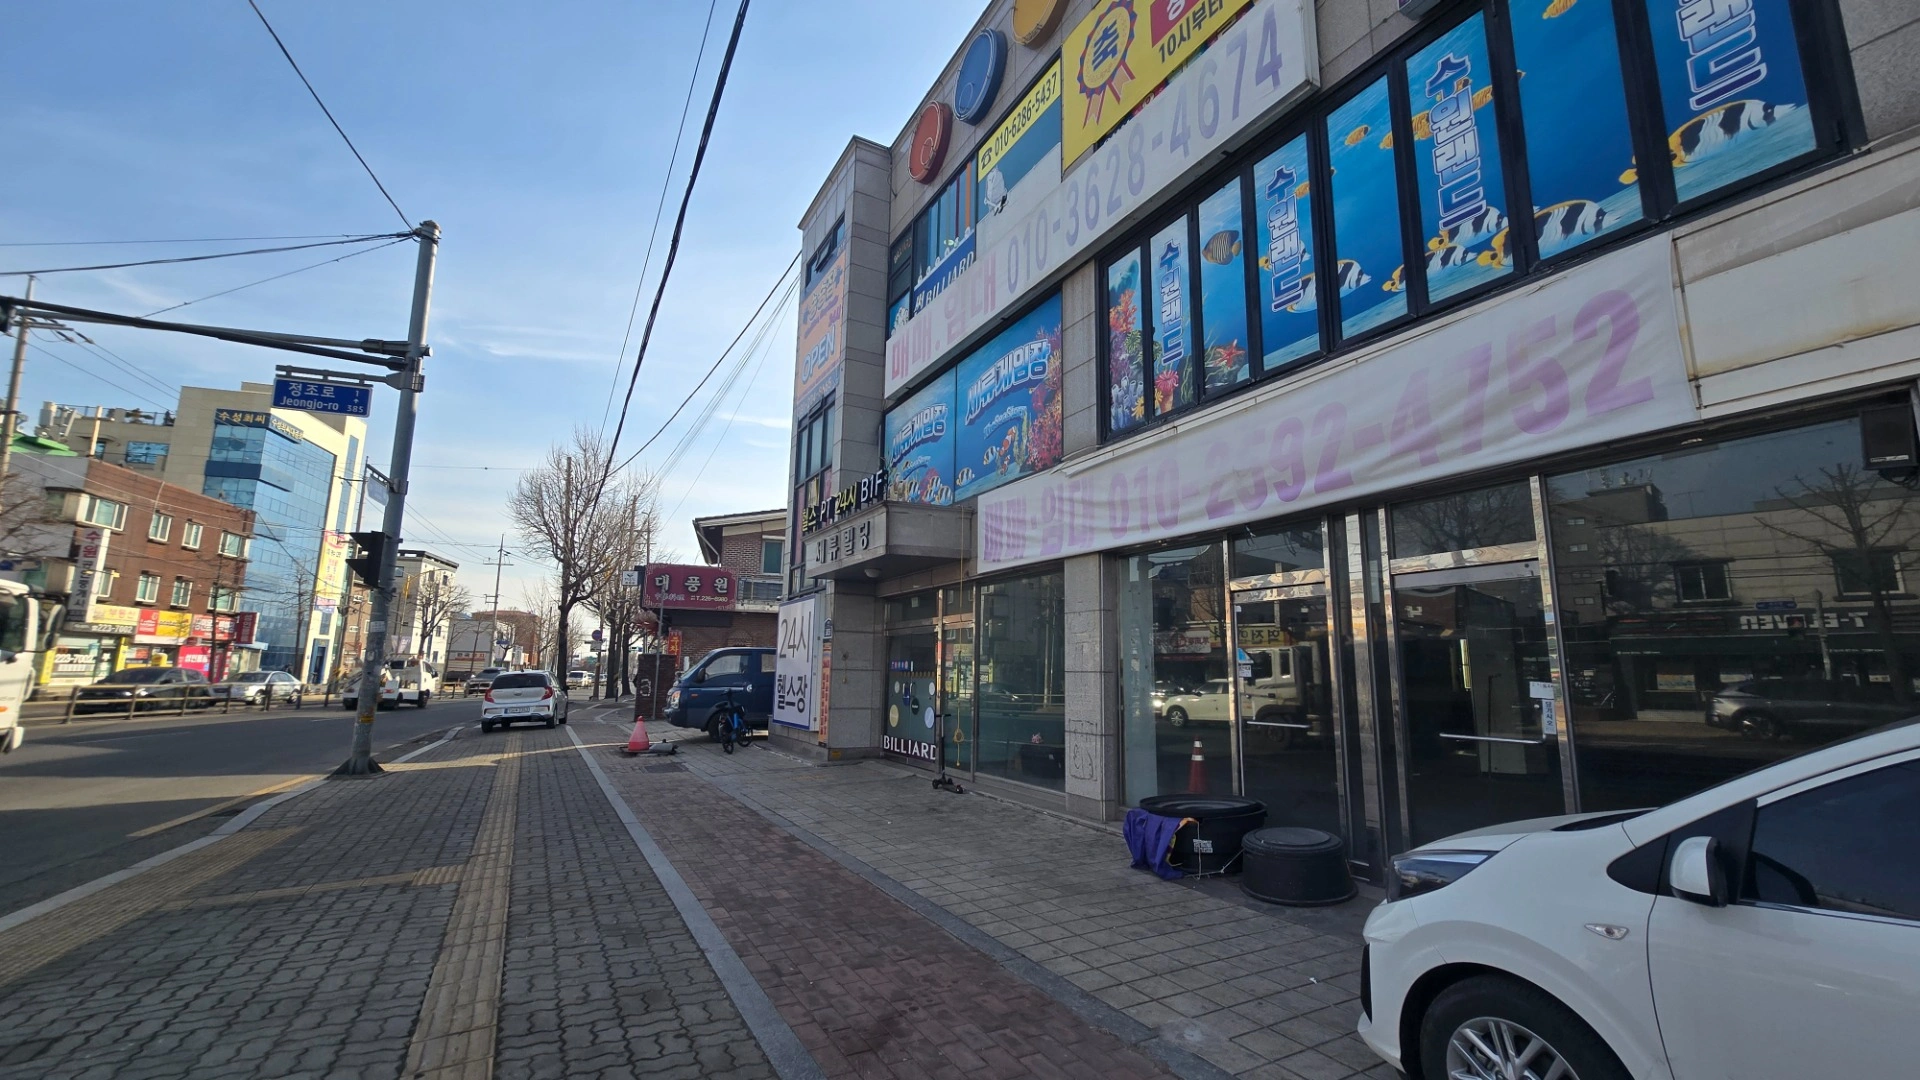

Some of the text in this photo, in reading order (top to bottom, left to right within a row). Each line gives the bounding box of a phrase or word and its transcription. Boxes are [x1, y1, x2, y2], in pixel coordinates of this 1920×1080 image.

[995, 71, 1058, 156] 010-6286-5437
[1006, 4, 1283, 293] 010-3628-4674
[1425, 52, 1487, 231] 수원랜드
[1265, 166, 1304, 314] 수원랜드
[1158, 239, 1184, 366] 수원랜드
[801, 324, 836, 385] OPEN
[280, 396, 339, 411] Jeongjo-ro
[288, 383, 335, 398] 정조로
[965, 338, 1051, 425] 세류게임장
[889, 403, 949, 463] 세류게임장
[1107, 289, 1655, 541] 010-2592-4752
[820, 496, 832, 523] PT
[834, 481, 858, 515] 24시
[83, 530, 101, 559] 수원
[816, 520, 871, 563] 세류빌딩
[654, 574, 728, 594] 대풍원
[97, 624, 134, 634] 223-7002
[779, 611, 812, 664] 24시
[777, 673, 808, 714] 헬스장
[883, 735, 937, 760] BILLIARD
